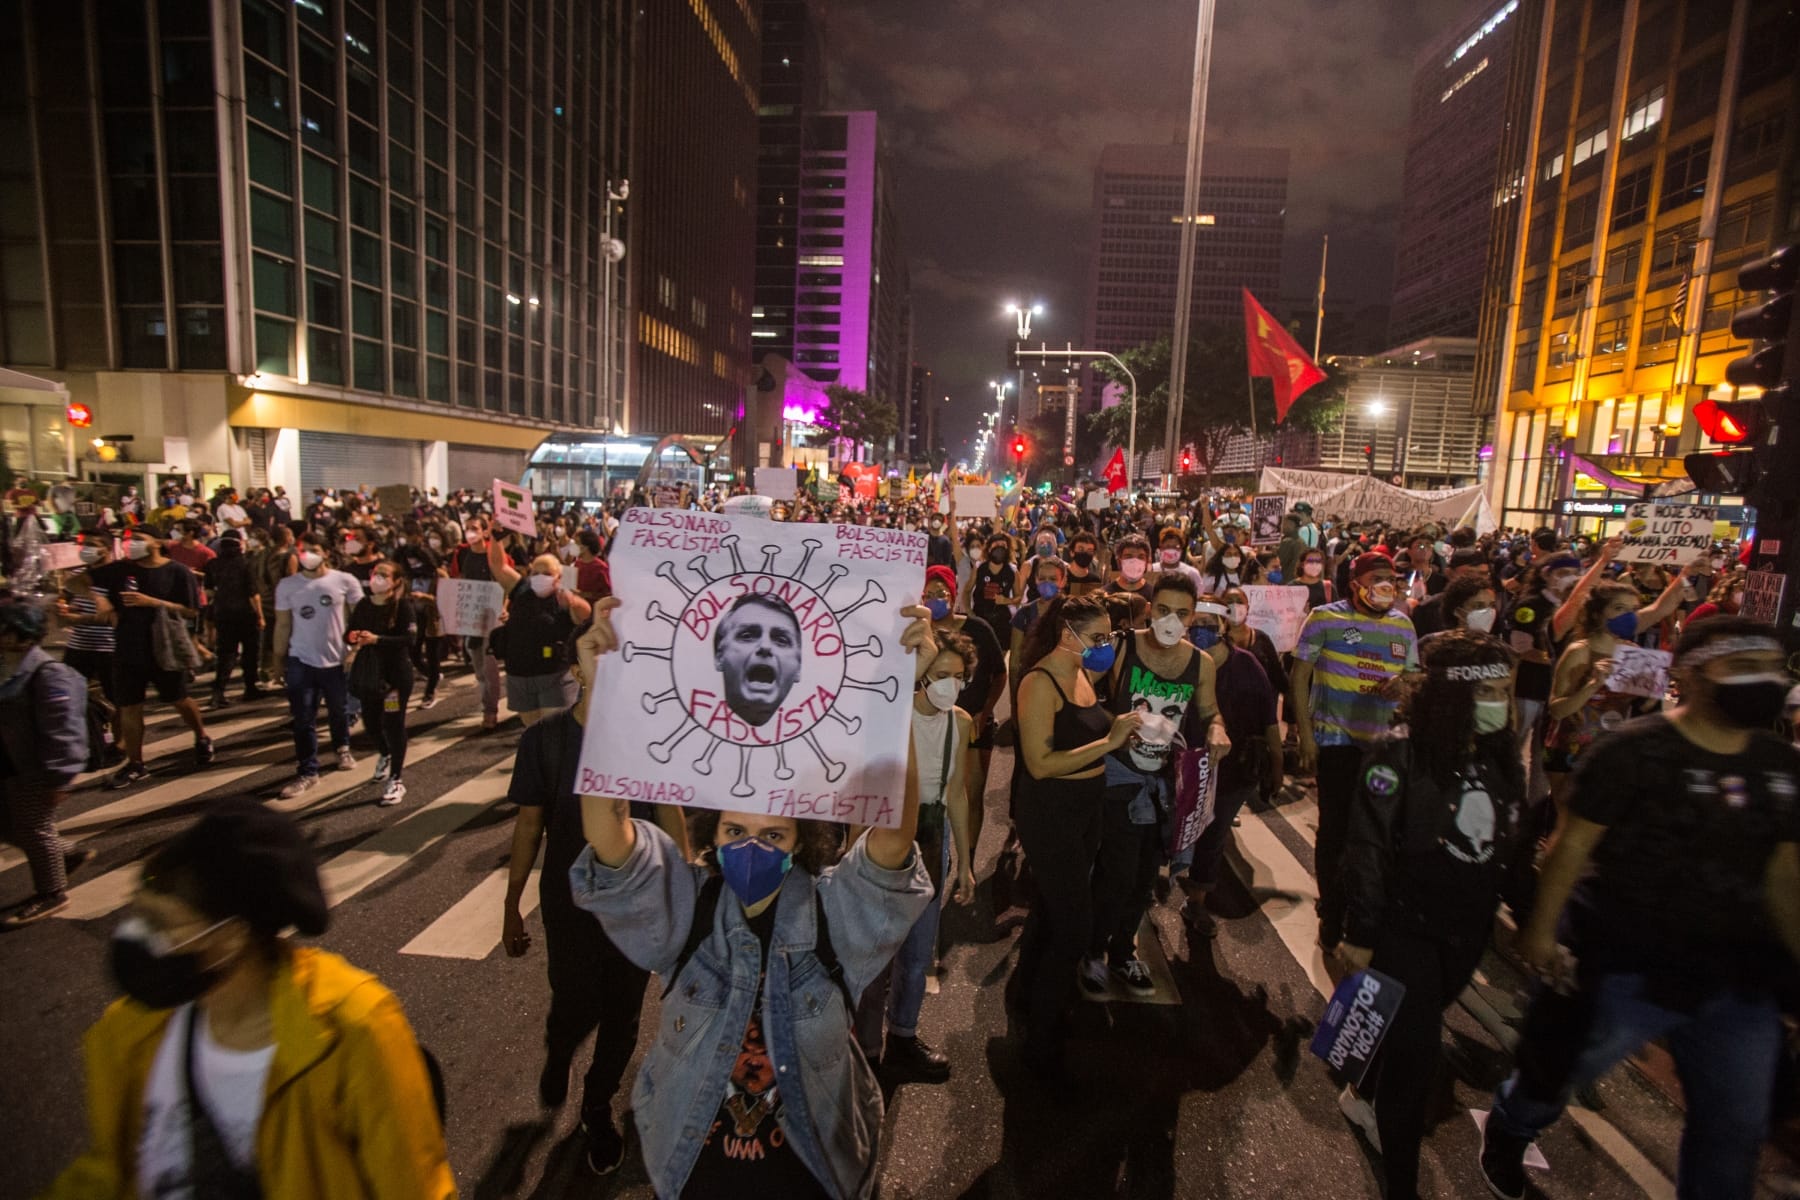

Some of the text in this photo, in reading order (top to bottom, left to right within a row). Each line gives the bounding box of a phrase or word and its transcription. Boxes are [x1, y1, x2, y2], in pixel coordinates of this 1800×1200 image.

[1280, 471, 1329, 489] ABAIXO
[1255, 498, 1283, 510] DENIS
[1632, 504, 1648, 518] SE
[1655, 505, 1682, 519] HOJE
[625, 507, 732, 535] BOLSONARO
[1652, 520, 1692, 535] LUTO
[836, 525, 928, 550] BOLSONARO
[1638, 548, 1677, 560] LUTA
[683, 574, 842, 657] BOLSONARO
[580, 768, 695, 803] BOLSONARO
[1327, 974, 1381, 1071] BOLSONARO!
[1350, 1010, 1385, 1061] #FORA
